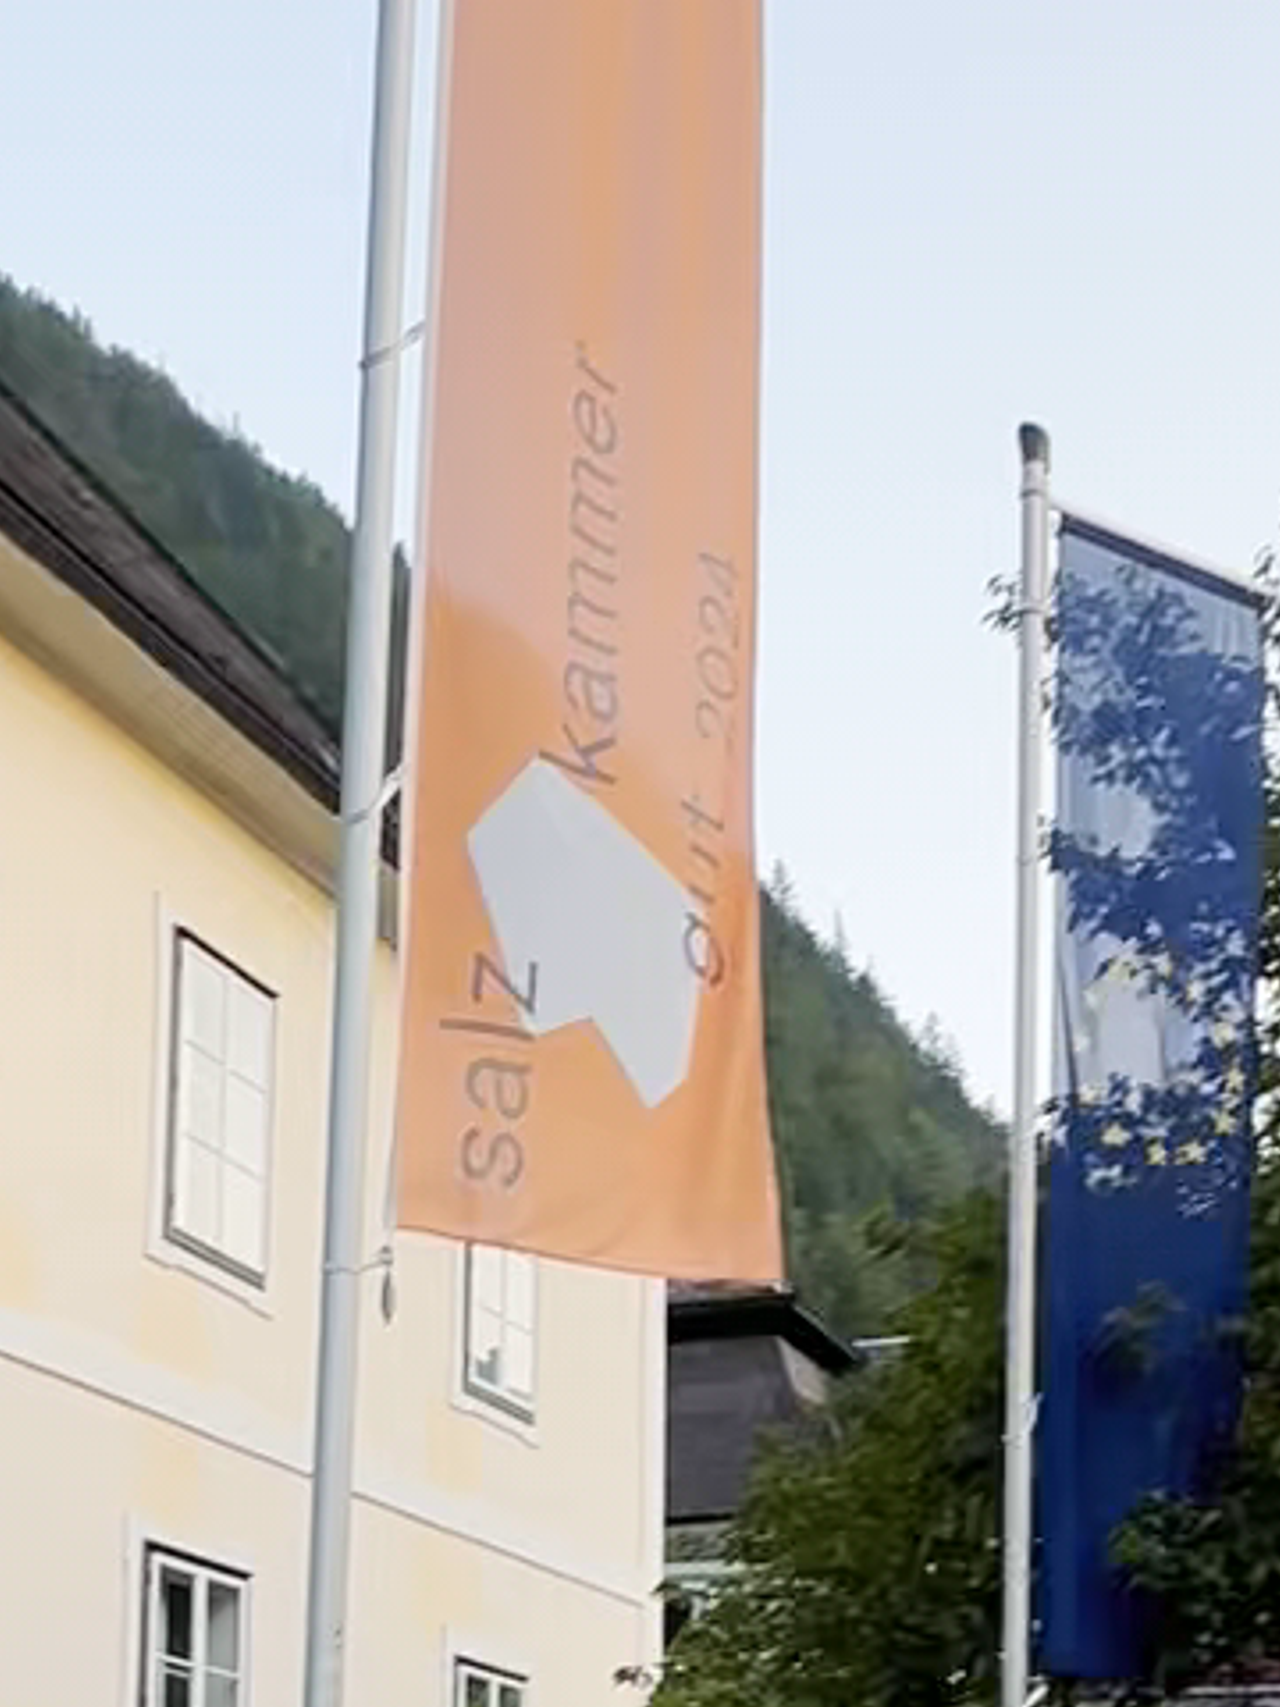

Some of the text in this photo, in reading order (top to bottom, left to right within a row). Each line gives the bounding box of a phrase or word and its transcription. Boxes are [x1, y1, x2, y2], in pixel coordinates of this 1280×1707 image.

[538, 339, 619, 786] kammer
[680, 550, 740, 988] gut 2024
[438, 949, 538, 1190] salz
